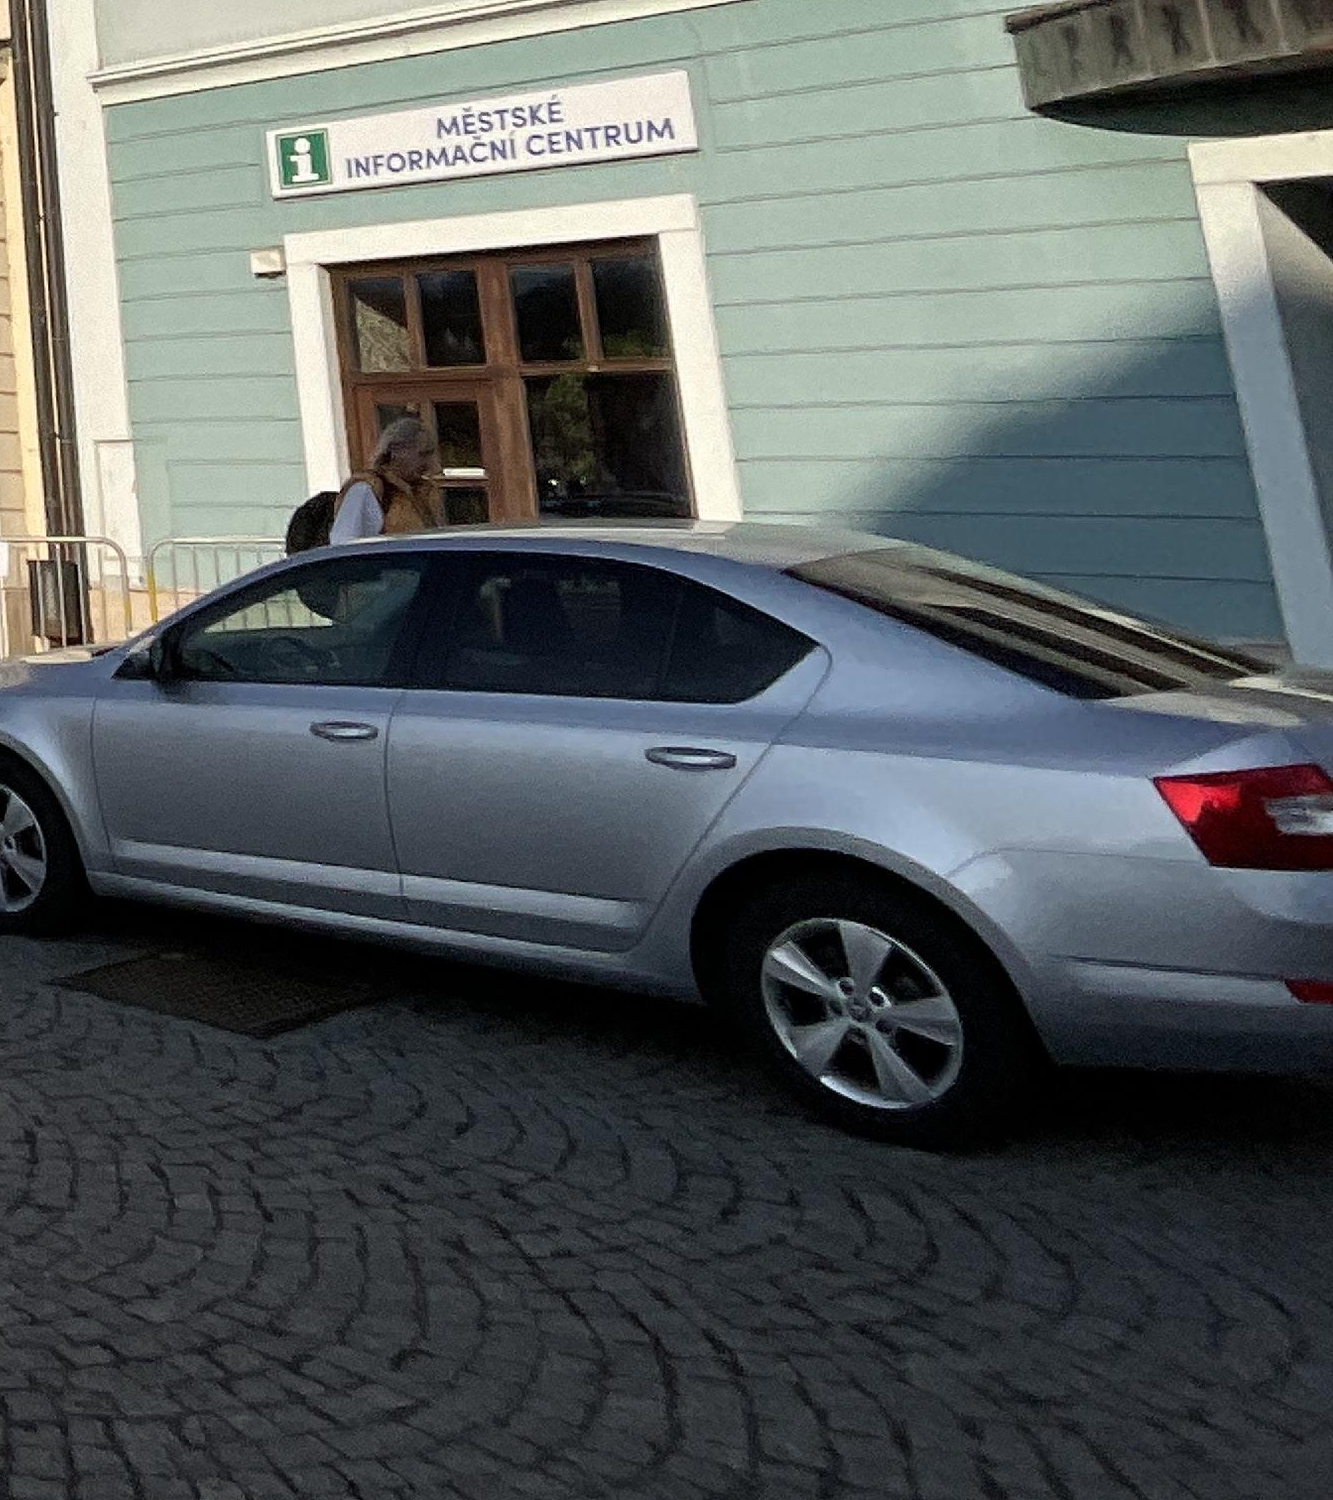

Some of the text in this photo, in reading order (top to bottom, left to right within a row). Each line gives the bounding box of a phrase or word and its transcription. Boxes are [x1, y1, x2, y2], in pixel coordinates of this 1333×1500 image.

[436, 94, 564, 139] MĚSTSKÉ
[345, 117, 676, 179] INFORMAČNÍ CENTRUM
